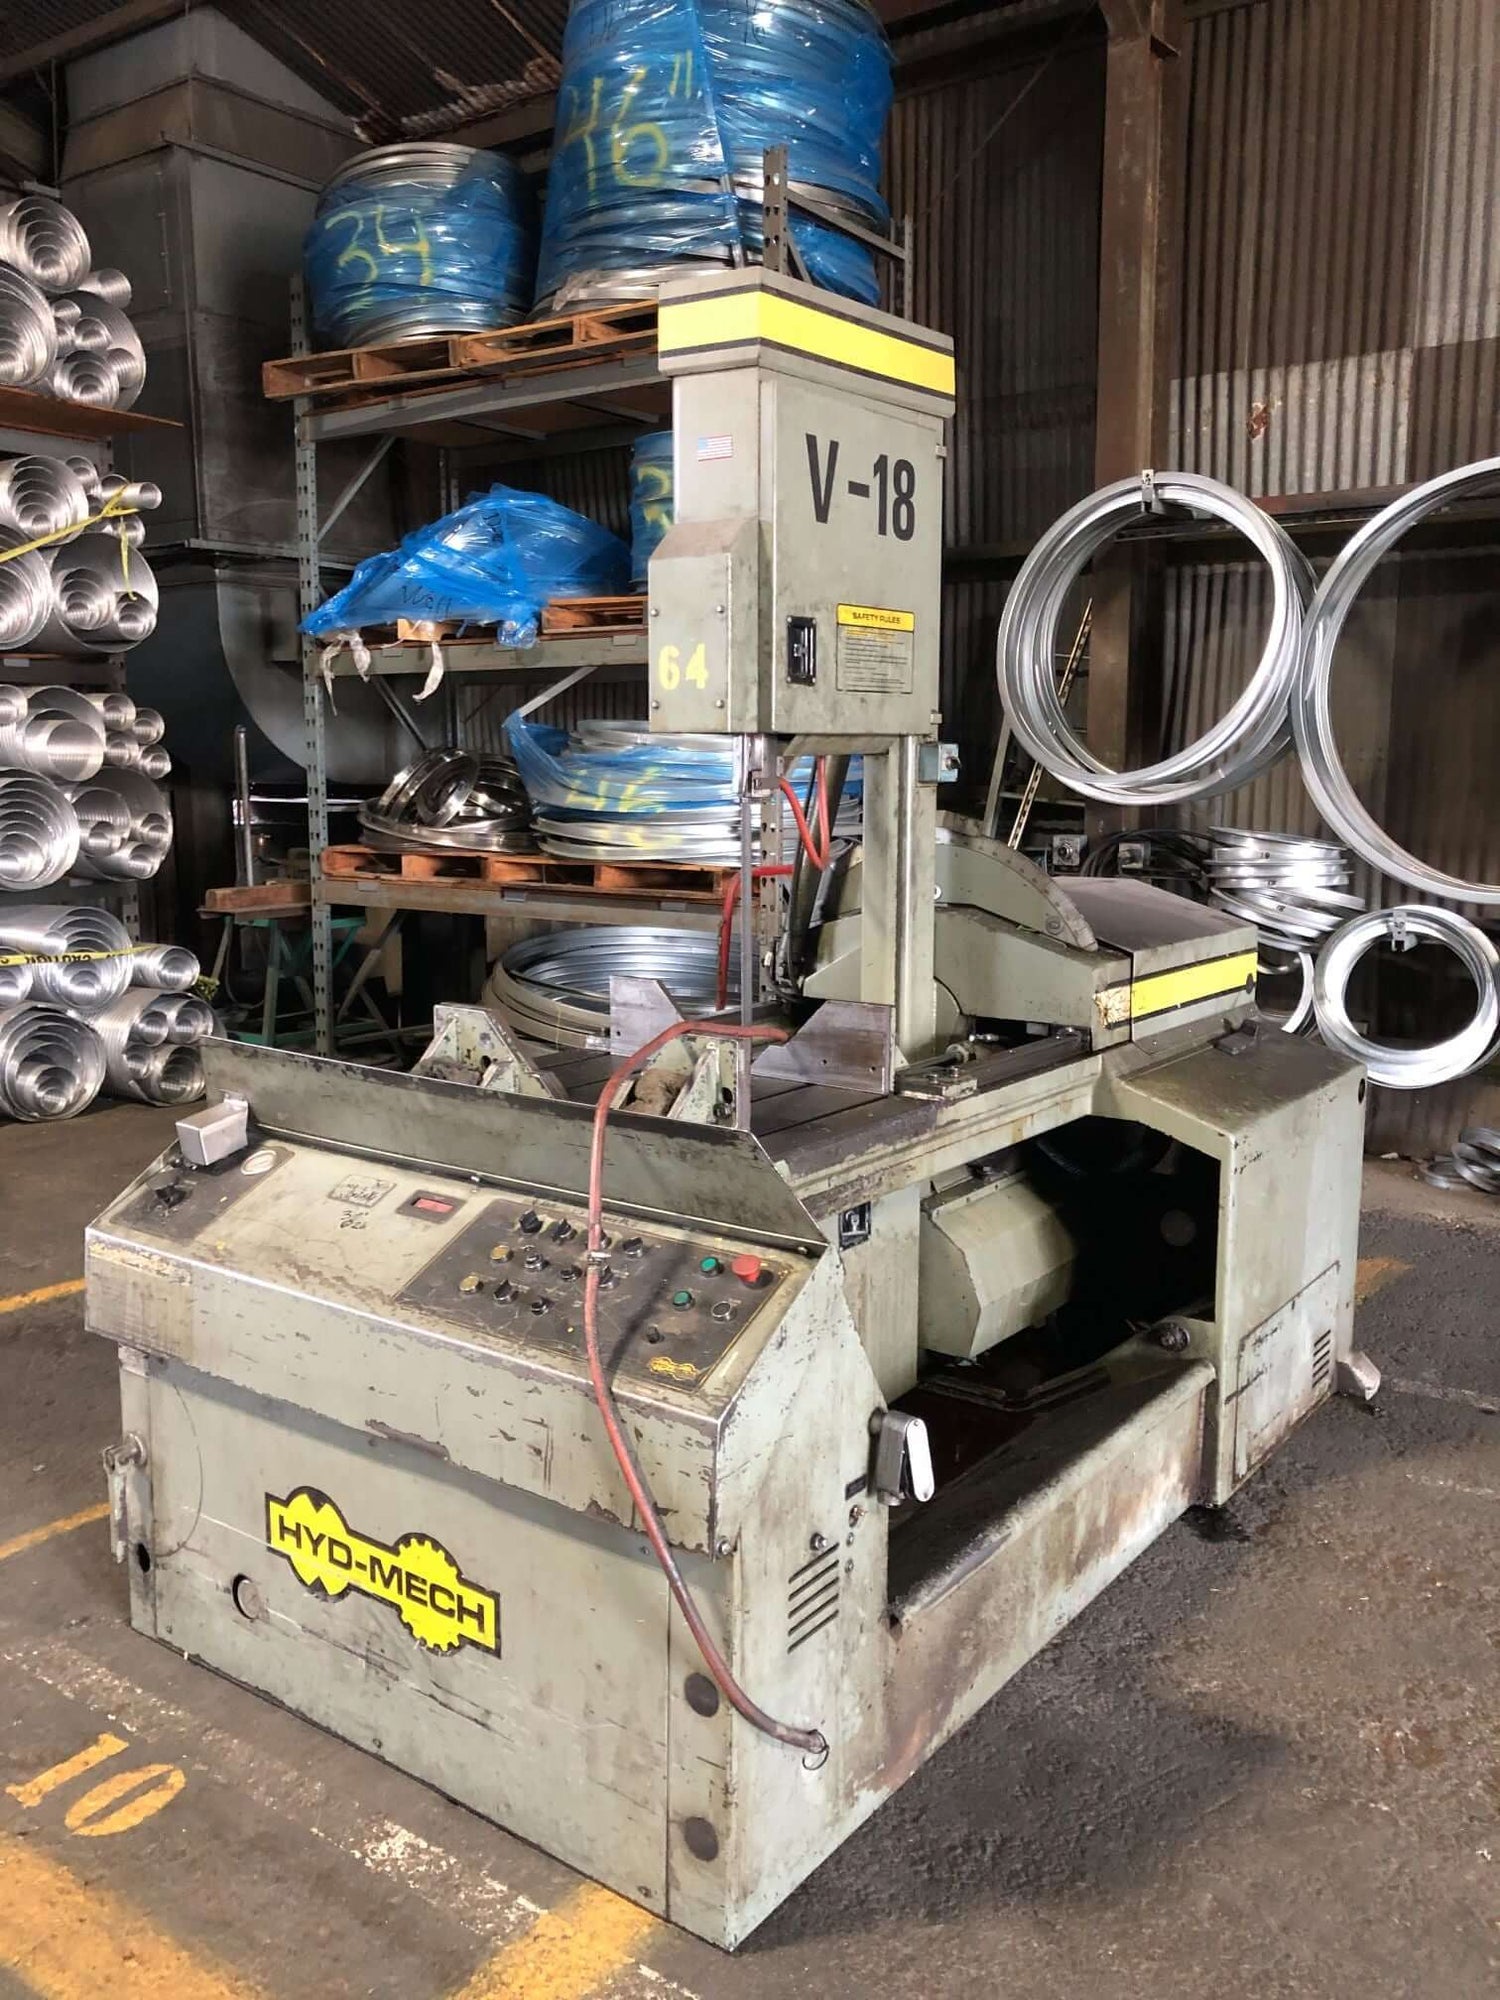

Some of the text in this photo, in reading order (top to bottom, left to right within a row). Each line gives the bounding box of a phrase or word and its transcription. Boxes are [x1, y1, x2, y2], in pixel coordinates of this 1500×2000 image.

[325, 205, 434, 308] 34
[805, 433, 916, 541] V-18
[658, 643, 709, 691] 64
[852, 612, 901, 625] SAFETY RULES
[278, 1514, 485, 1634] HYD-MECH
[5, 1732, 186, 1837] 10
